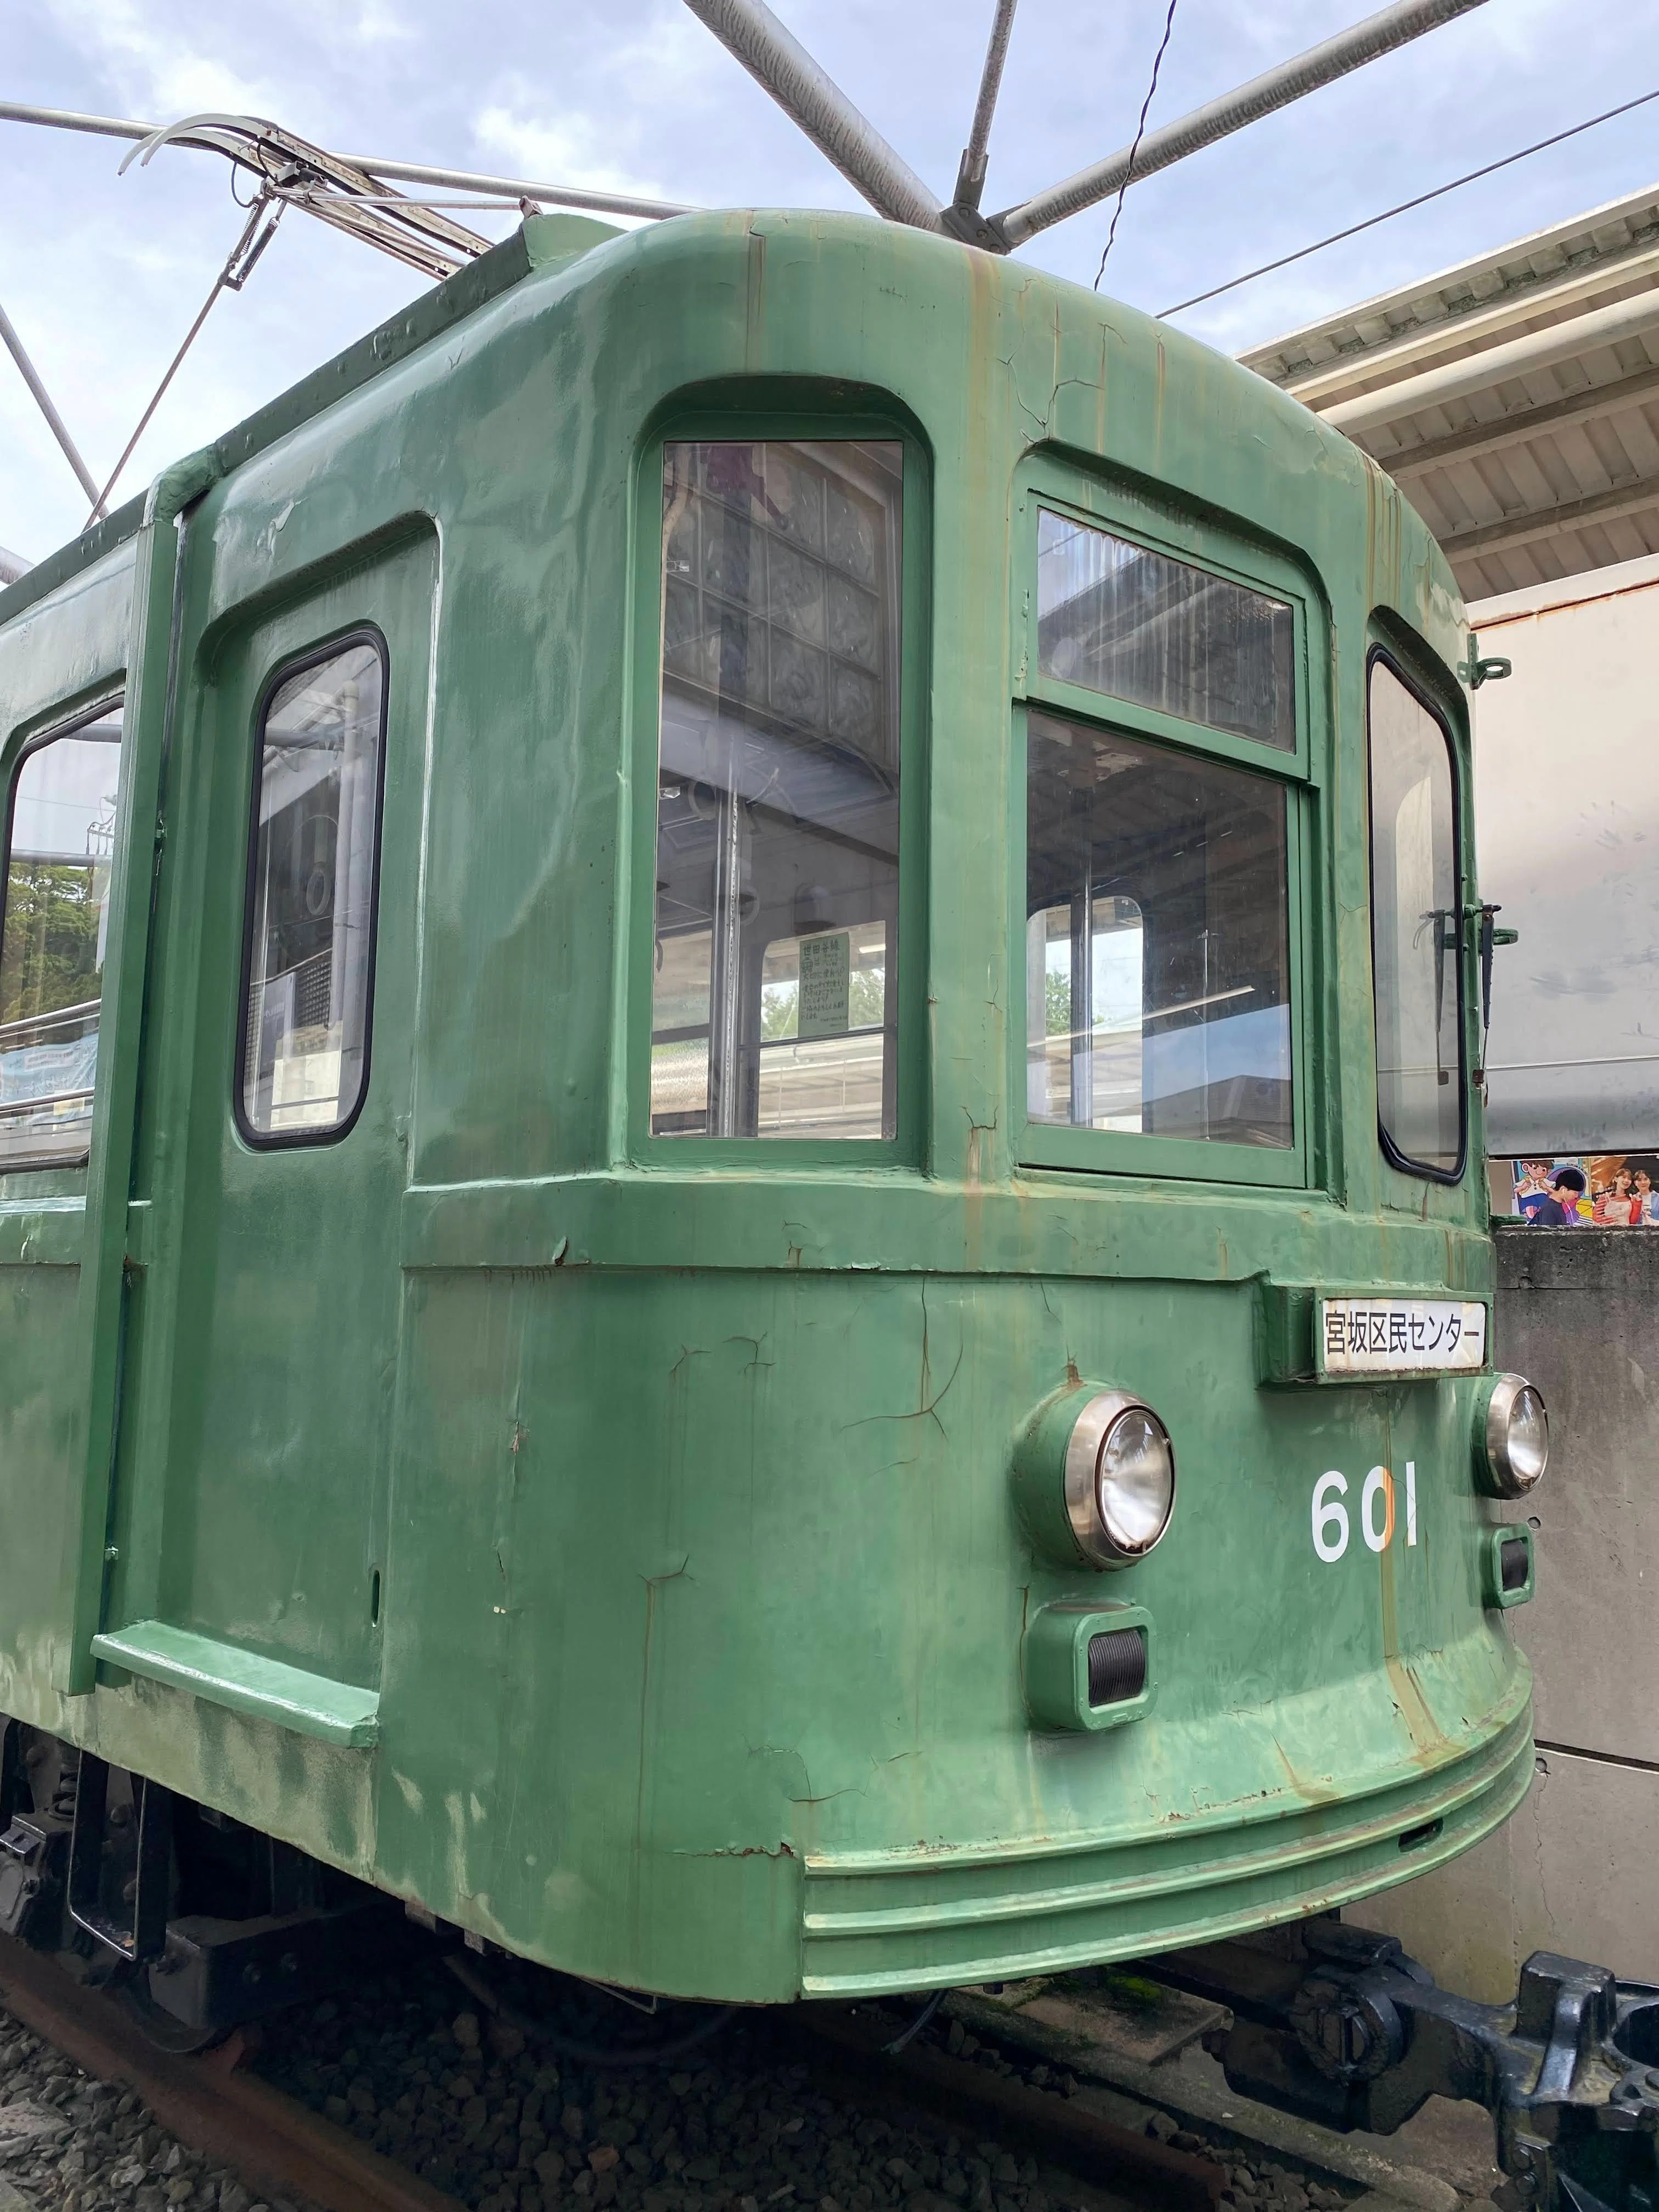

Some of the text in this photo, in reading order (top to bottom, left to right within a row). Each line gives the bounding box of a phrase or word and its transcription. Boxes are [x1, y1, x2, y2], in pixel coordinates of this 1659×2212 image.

[1325, 1310, 1480, 1355] 宮坂区民センター
[1311, 1460, 1417, 1563] 601
